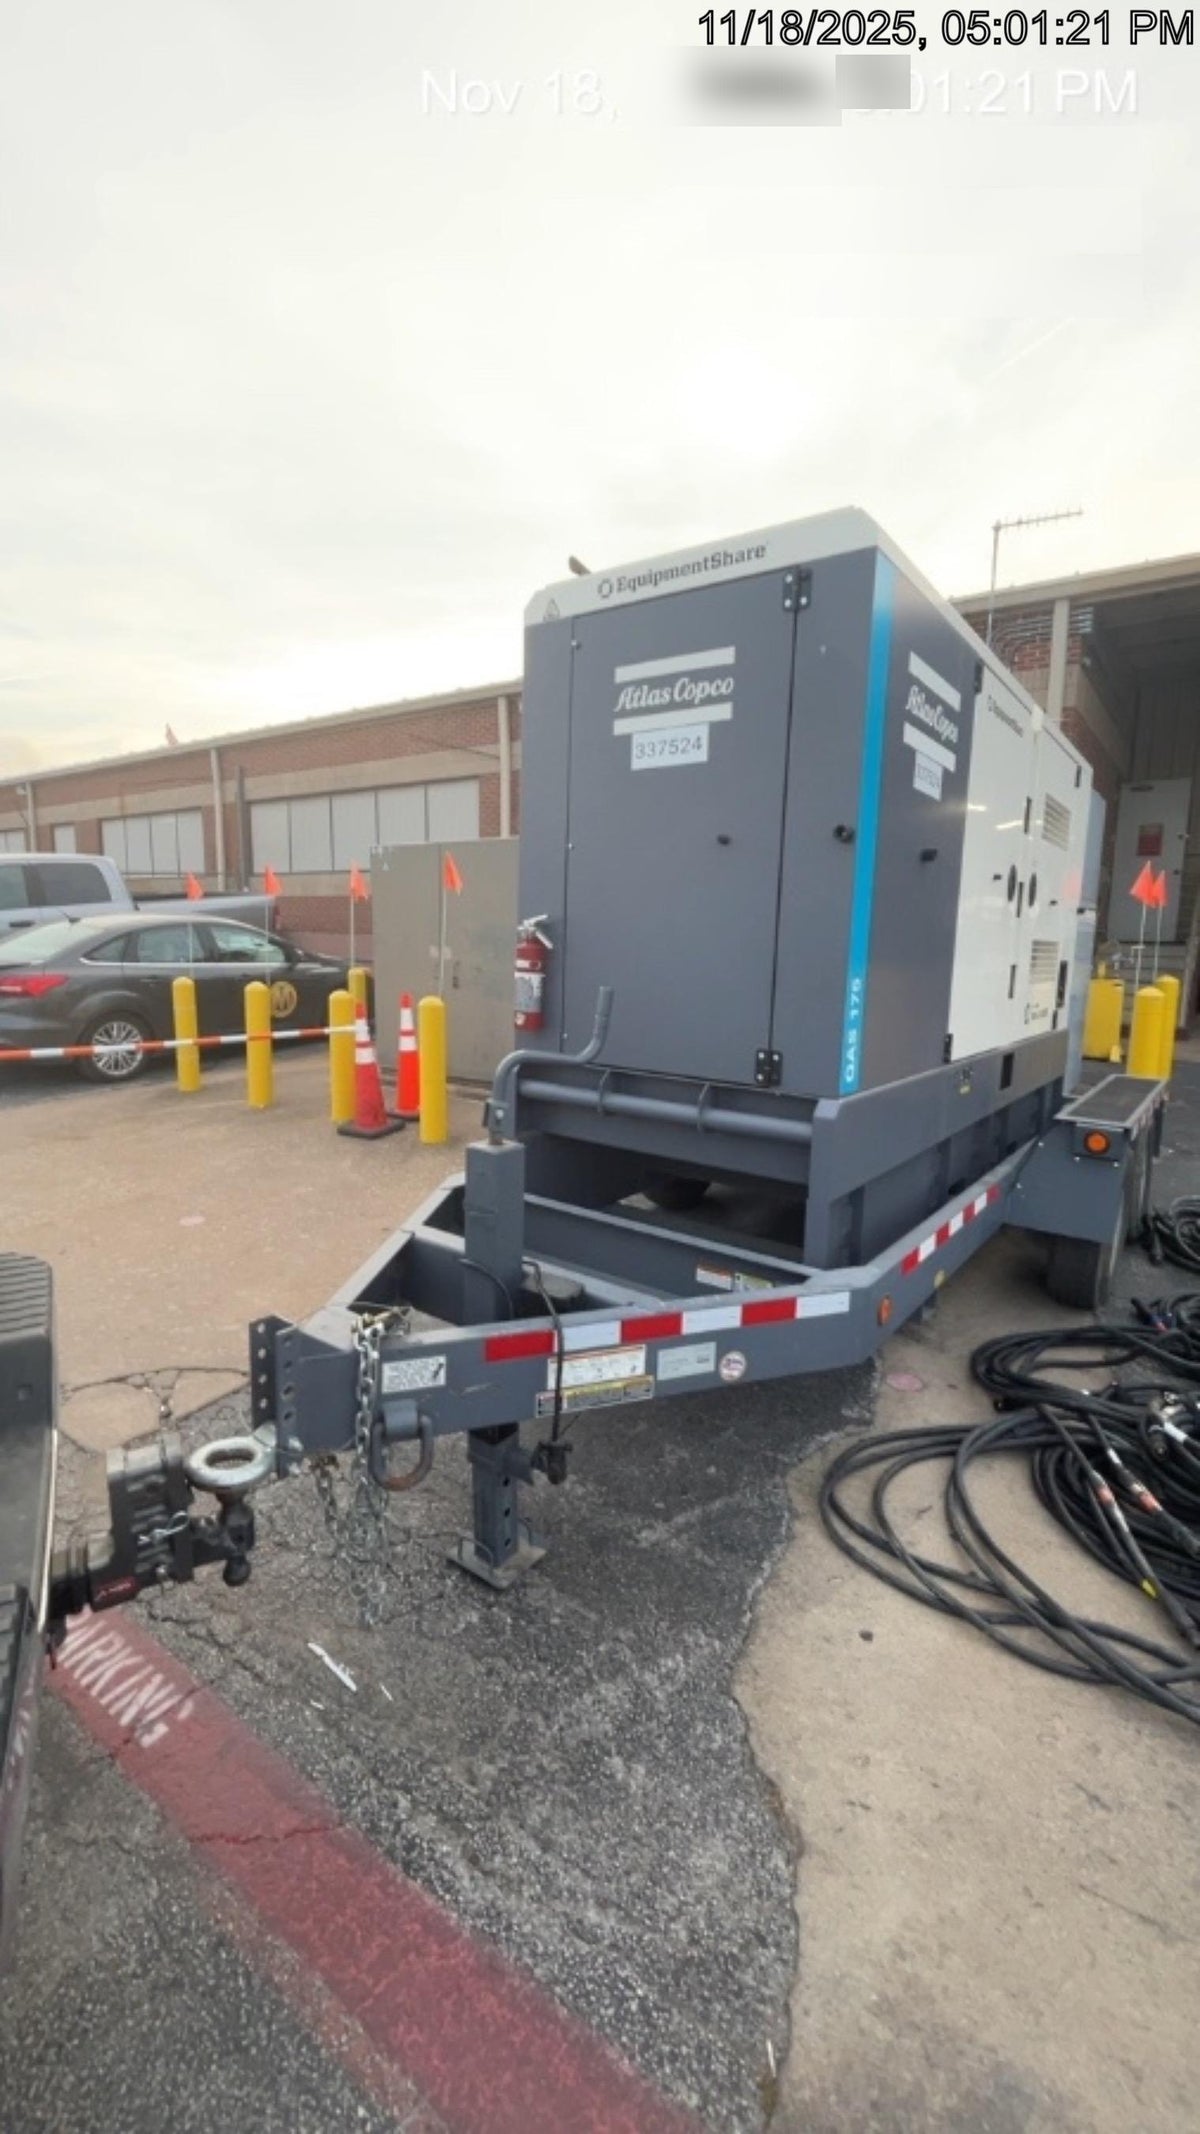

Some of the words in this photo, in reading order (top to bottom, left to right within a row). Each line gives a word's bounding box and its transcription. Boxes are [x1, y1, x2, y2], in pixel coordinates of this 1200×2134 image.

[616, 544, 767, 592] EquipmentShare
[613, 684, 672, 712] Atlas
[673, 677, 734, 705] Copco
[635, 735, 702, 759] 337524
